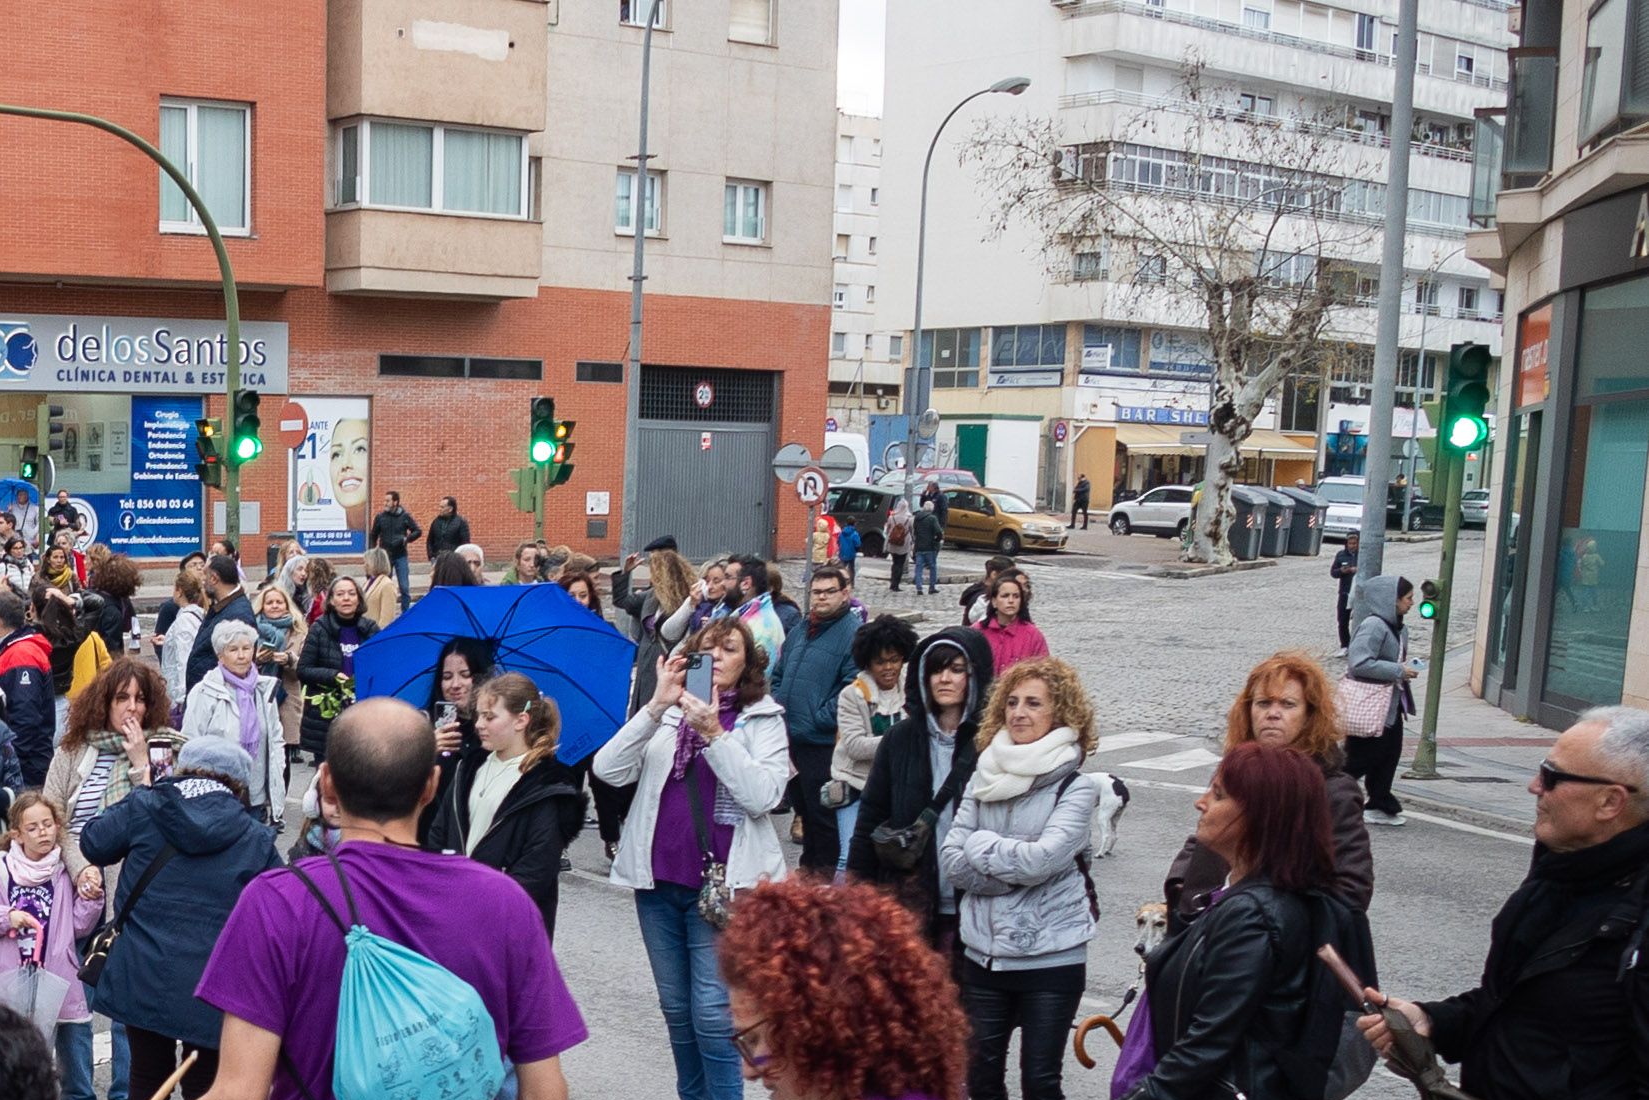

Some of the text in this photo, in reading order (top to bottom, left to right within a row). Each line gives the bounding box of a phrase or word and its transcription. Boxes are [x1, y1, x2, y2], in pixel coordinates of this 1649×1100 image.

[56, 322, 267, 366] delosSantos
[57, 367, 267, 386] CLÍNICA DENTAL & ESTICA
[1121, 407, 1204, 423] BAR SHE
[165, 472, 174, 480] de
[136, 499, 154, 509] 856
[155, 499, 168, 509] 08
[169, 499, 181, 509] 03
[182, 499, 194, 509] 64
